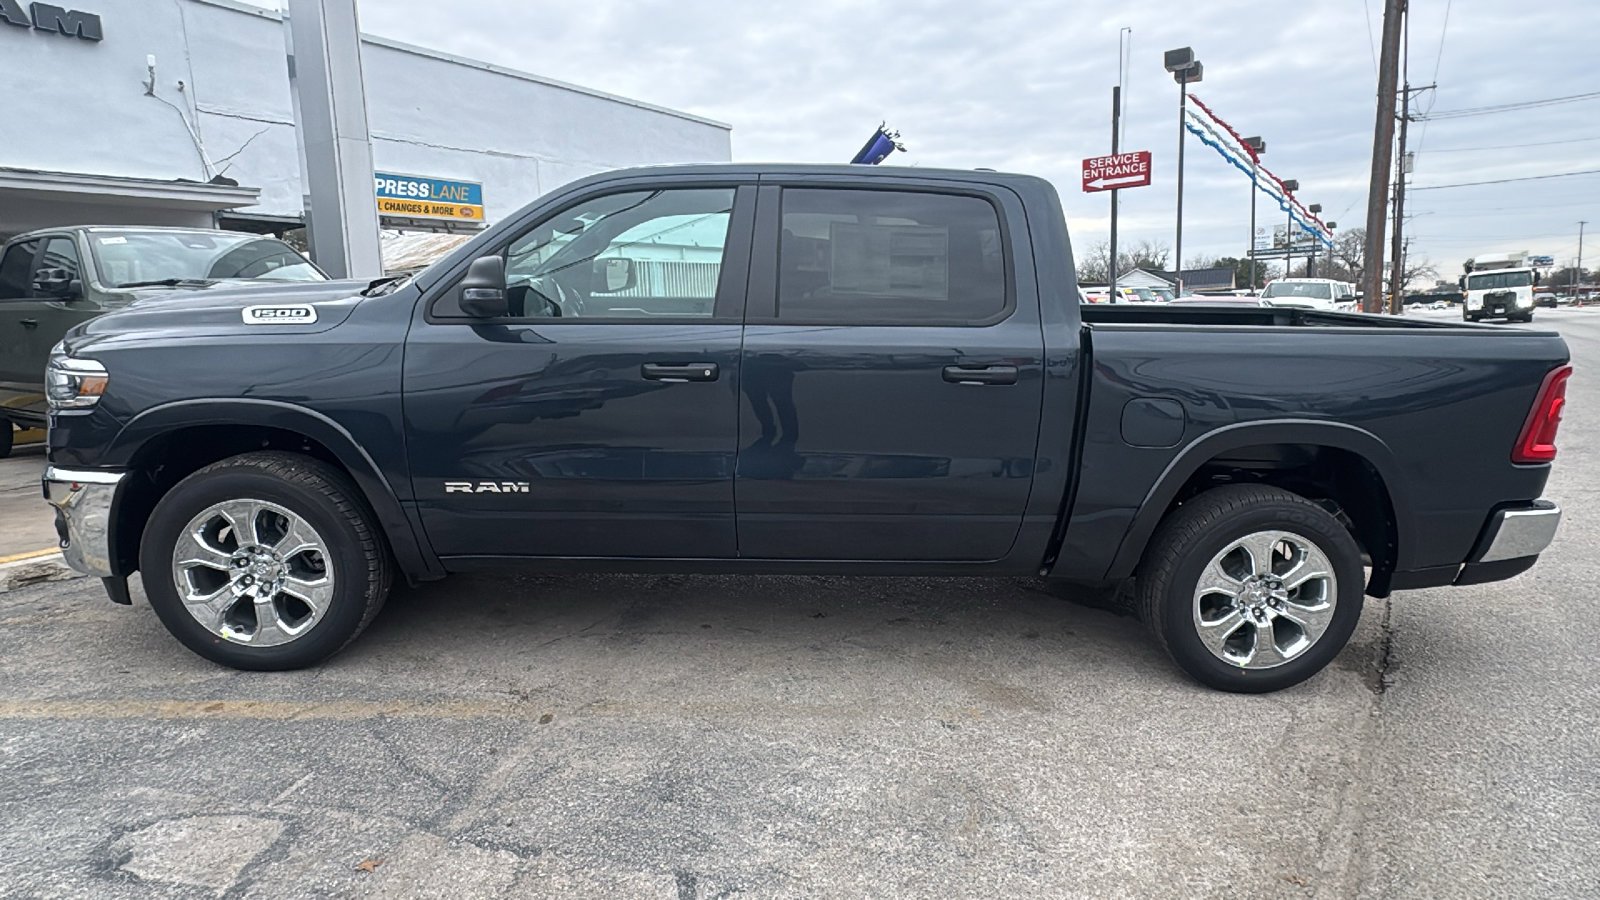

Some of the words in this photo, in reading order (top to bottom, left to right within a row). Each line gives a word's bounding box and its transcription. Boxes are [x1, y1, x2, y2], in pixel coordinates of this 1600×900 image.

[1090, 153, 1140, 168] SERVICE
[1083, 162, 1147, 179] ENTRANCE
[384, 202, 422, 214] CHANGES
[423, 205, 430, 214] &
[432, 206, 455, 216] MORE
[253, 309, 307, 318] 1500
[445, 482, 530, 493] RAM
